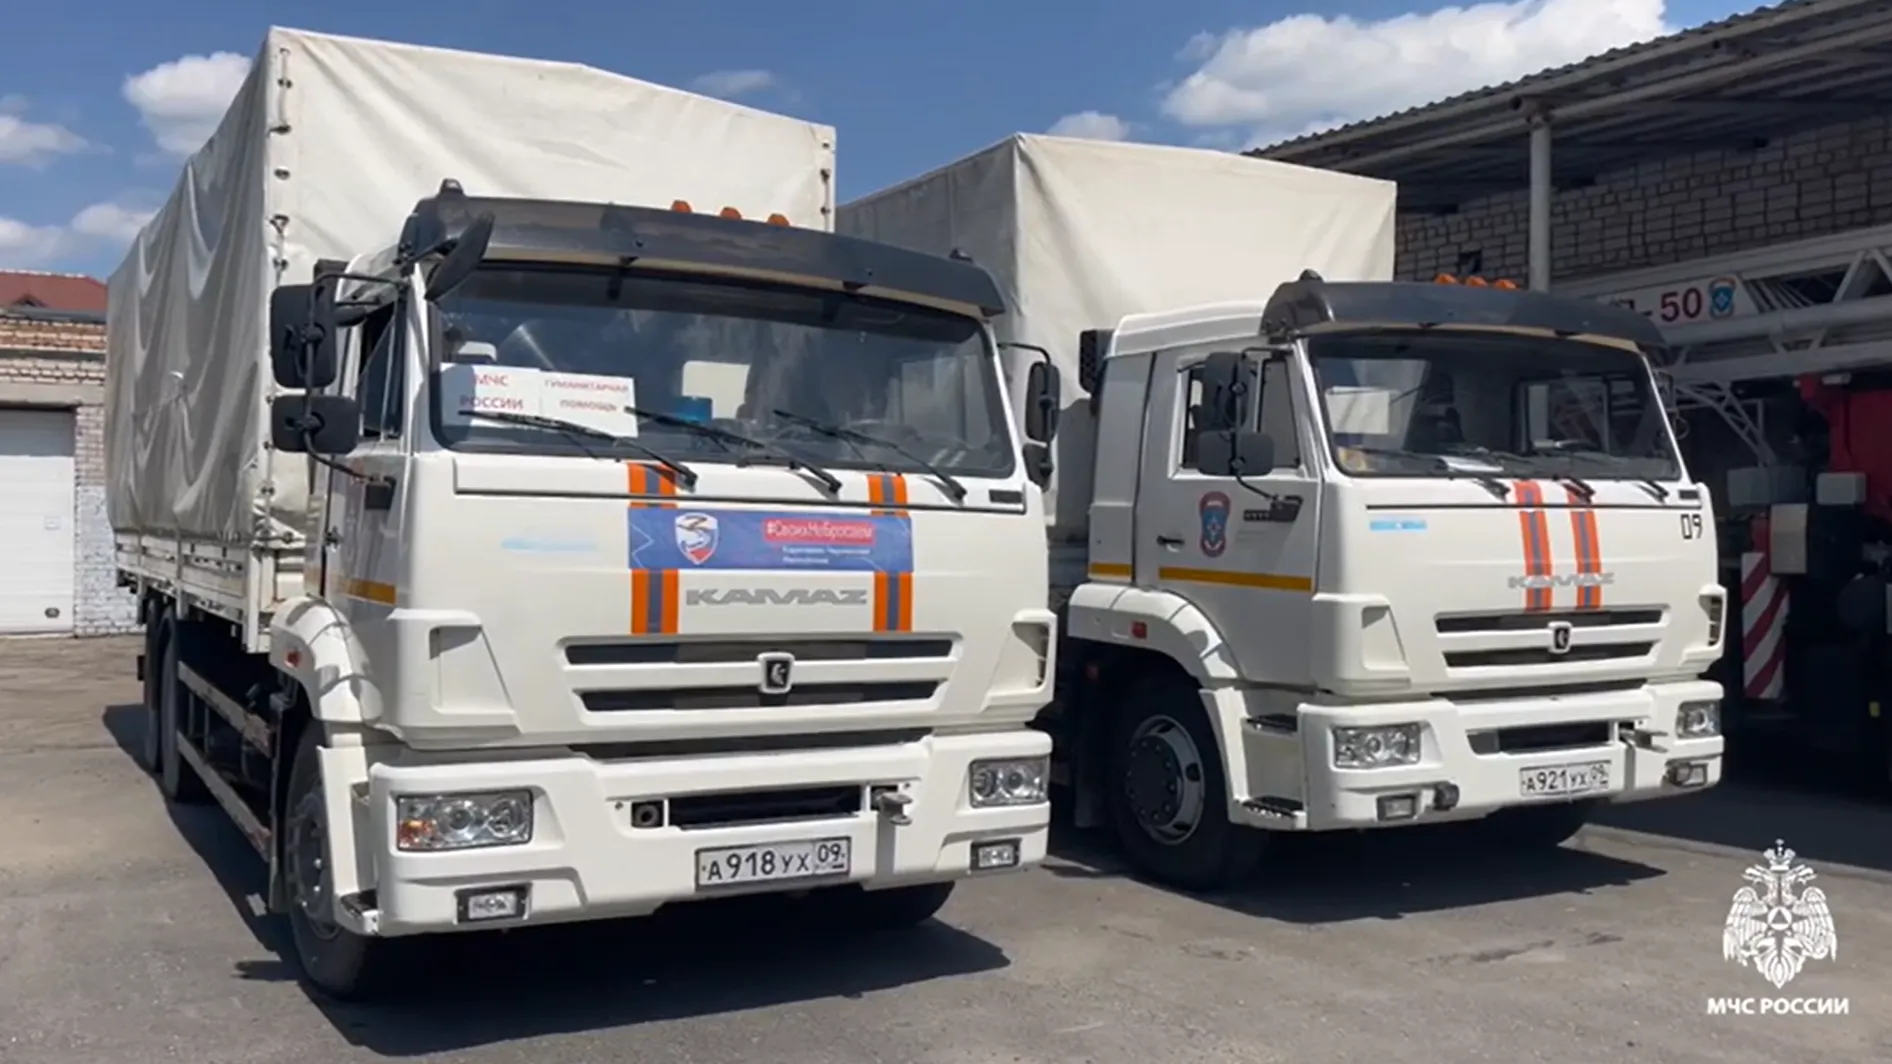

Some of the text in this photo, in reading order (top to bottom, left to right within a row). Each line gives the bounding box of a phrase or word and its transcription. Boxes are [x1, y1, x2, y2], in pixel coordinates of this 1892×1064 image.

[472, 374, 509, 387] МЧС
[459, 395, 524, 410] РОССИИ
[1680, 513, 1703, 539] 09
[1507, 571, 1615, 589] KAMAZ
[685, 588, 868, 606] KAMAZ
